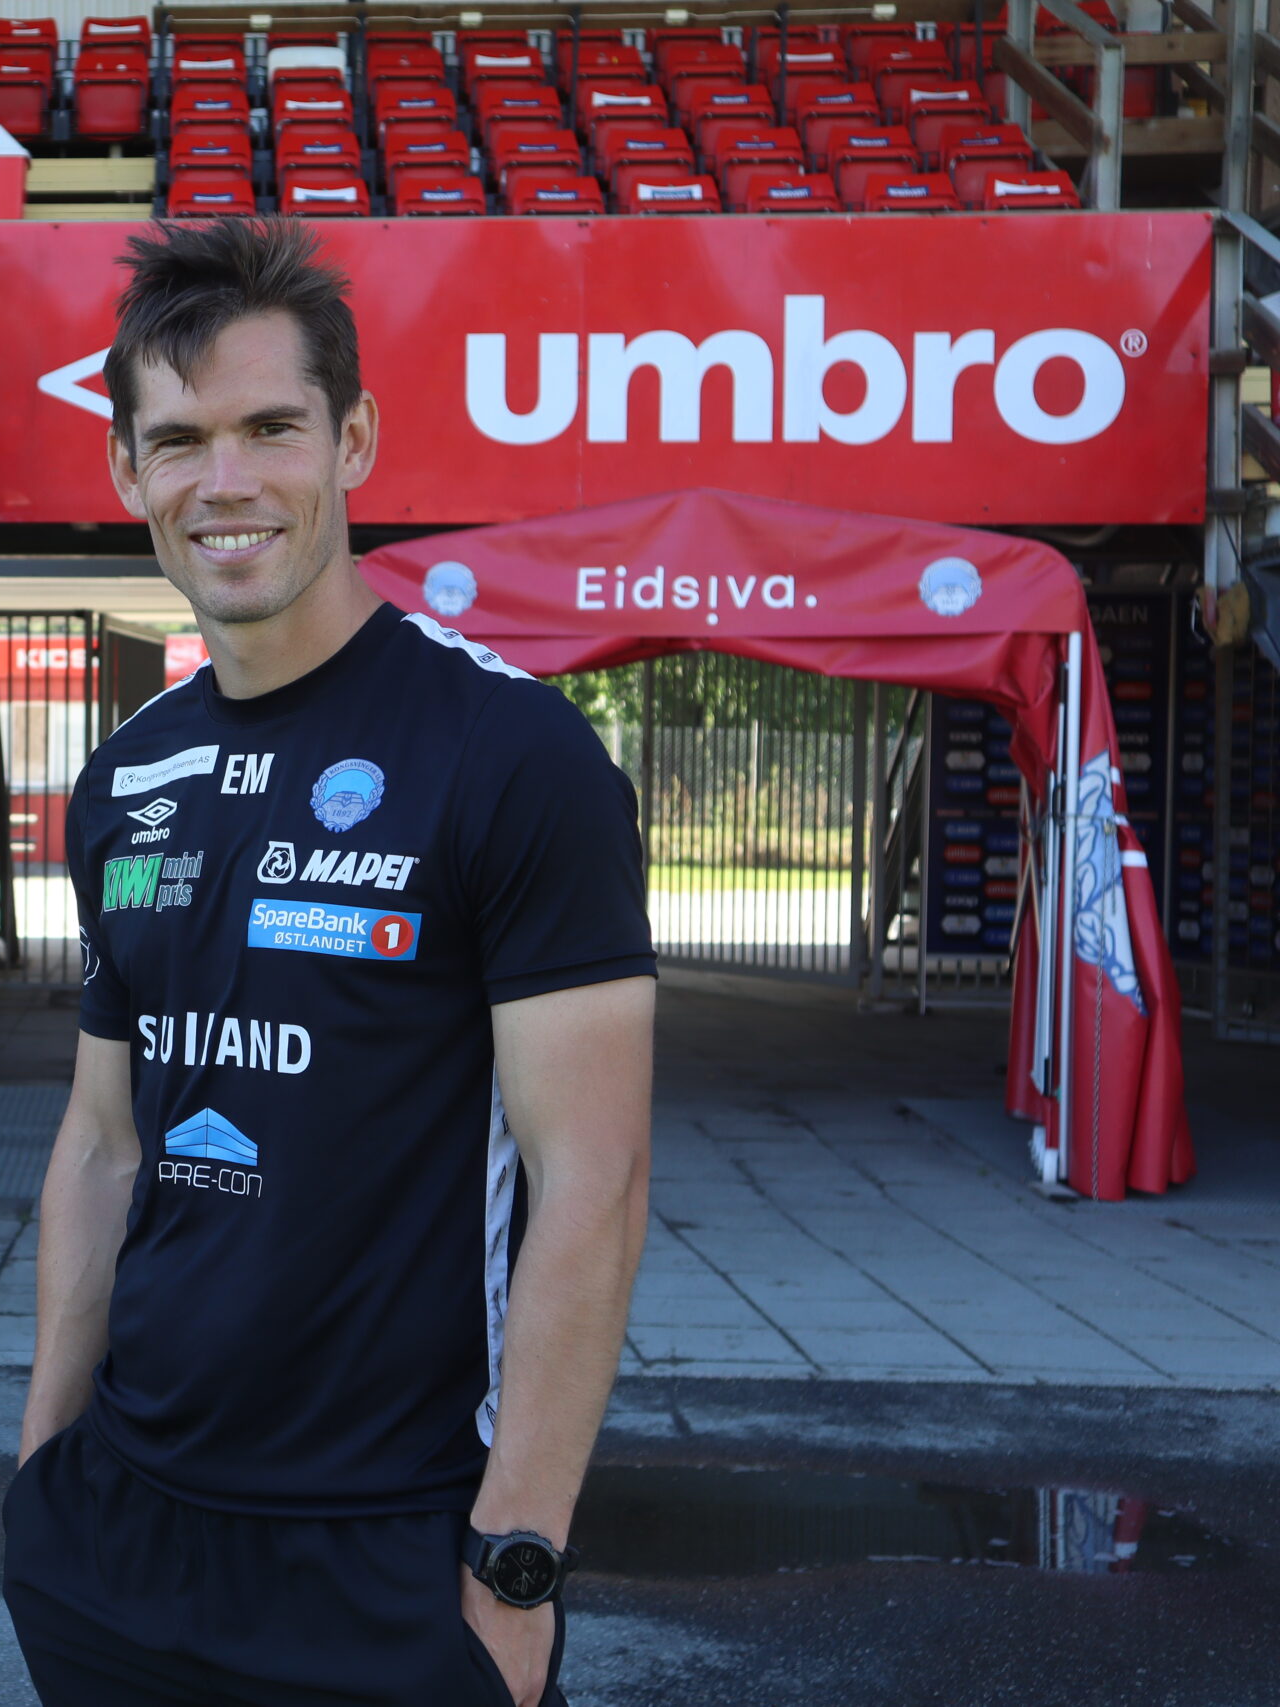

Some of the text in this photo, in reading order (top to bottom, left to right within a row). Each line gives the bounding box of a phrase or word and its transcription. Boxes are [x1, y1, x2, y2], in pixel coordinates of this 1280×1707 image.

[466, 294, 1126, 445] umbro
[198, 755, 210, 764] AS
[221, 753, 275, 795] EM
[131, 826, 170, 845] umbro
[162, 850, 204, 879] mini
[299, 849, 415, 891] MAPEI
[156, 878, 193, 913] pris
[252, 903, 401, 950] SpareBank 1
[274, 931, 366, 953] ØSTLANDET
